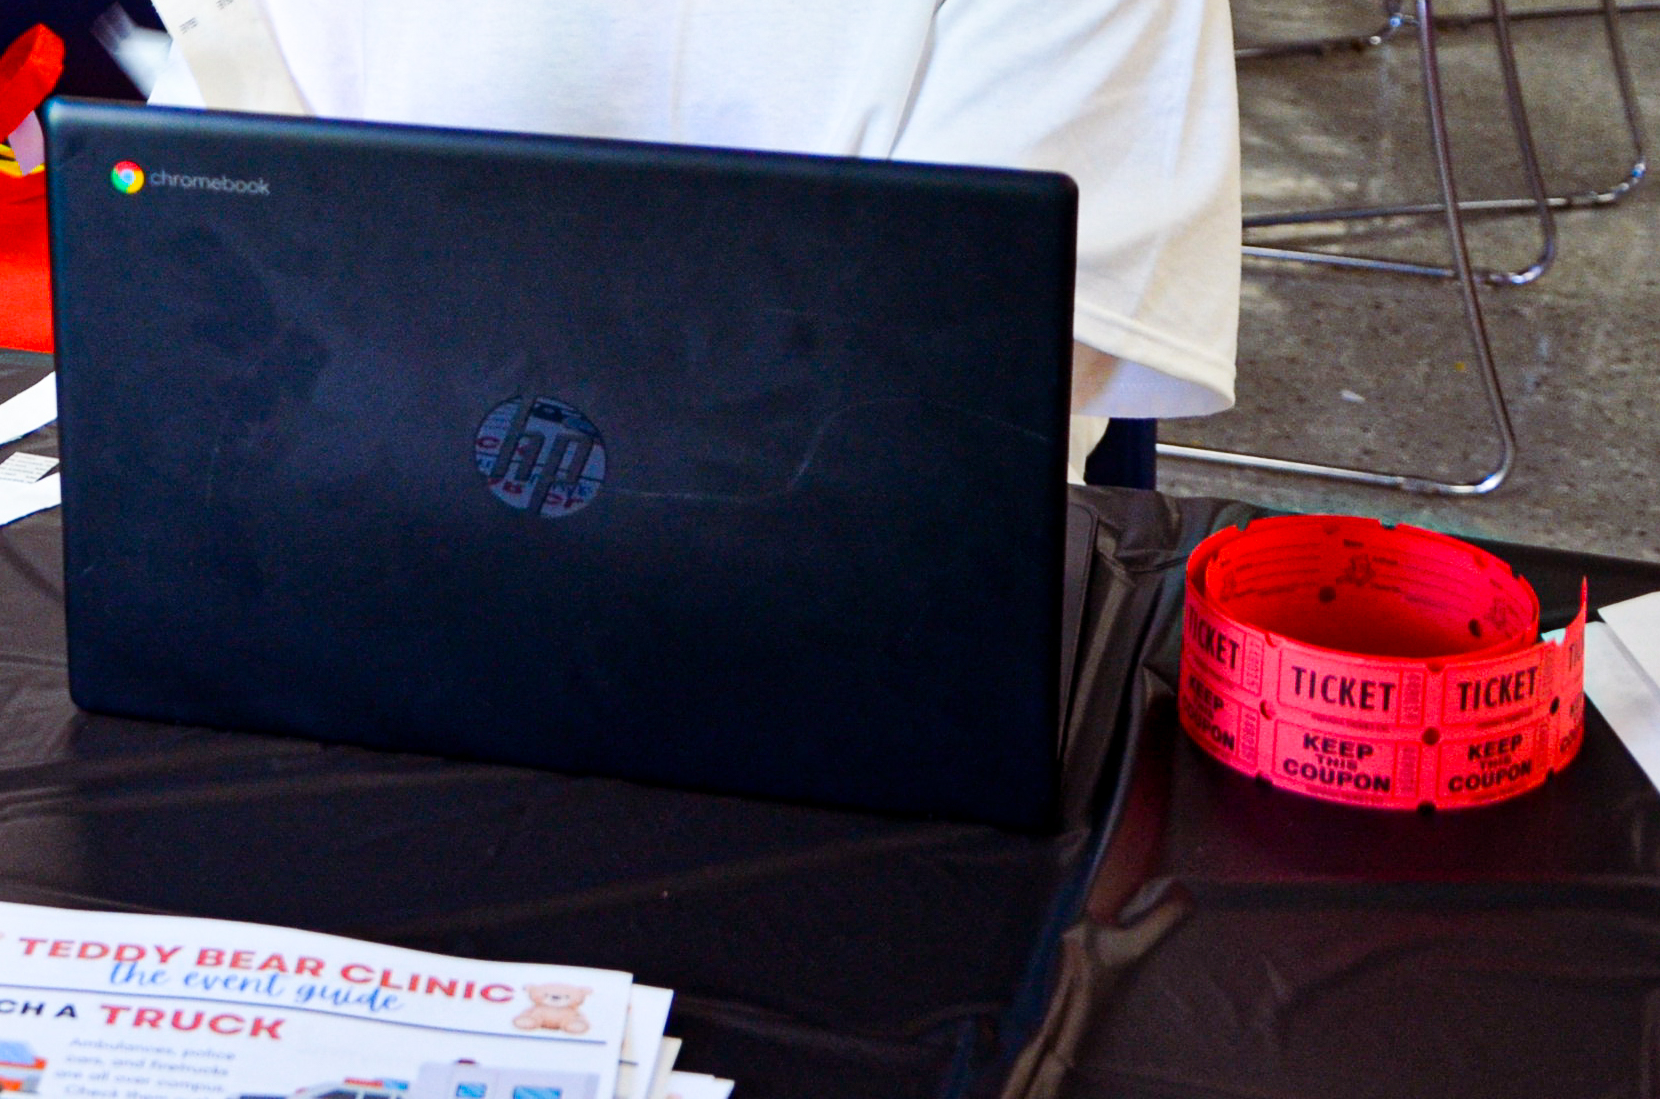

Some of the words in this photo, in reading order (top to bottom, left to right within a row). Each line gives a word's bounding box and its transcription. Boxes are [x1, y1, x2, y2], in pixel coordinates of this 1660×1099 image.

[150, 170, 270, 196] chromebook
[486, 395, 596, 517] hp
[1189, 605, 1240, 670] TICKET
[1291, 665, 1396, 712] TICKET
[1457, 666, 1539, 712] TICKET
[1303, 732, 1375, 761] KEEP
[1315, 753, 1359, 771] THIS
[1467, 733, 1524, 761] KEEP
[1283, 758, 1391, 793] COUPON
[1447, 760, 1532, 793] COUPON
[17, 936, 182, 966] TEDDY
[196, 947, 324, 978] BEAR
[340, 961, 515, 1004] CLINIC
[107, 960, 153, 988] the
[183, 969, 286, 998] event
[291, 982, 406, 1013] guide
[54, 1003, 79, 1019] A
[100, 1003, 287, 1040] TRUCK
